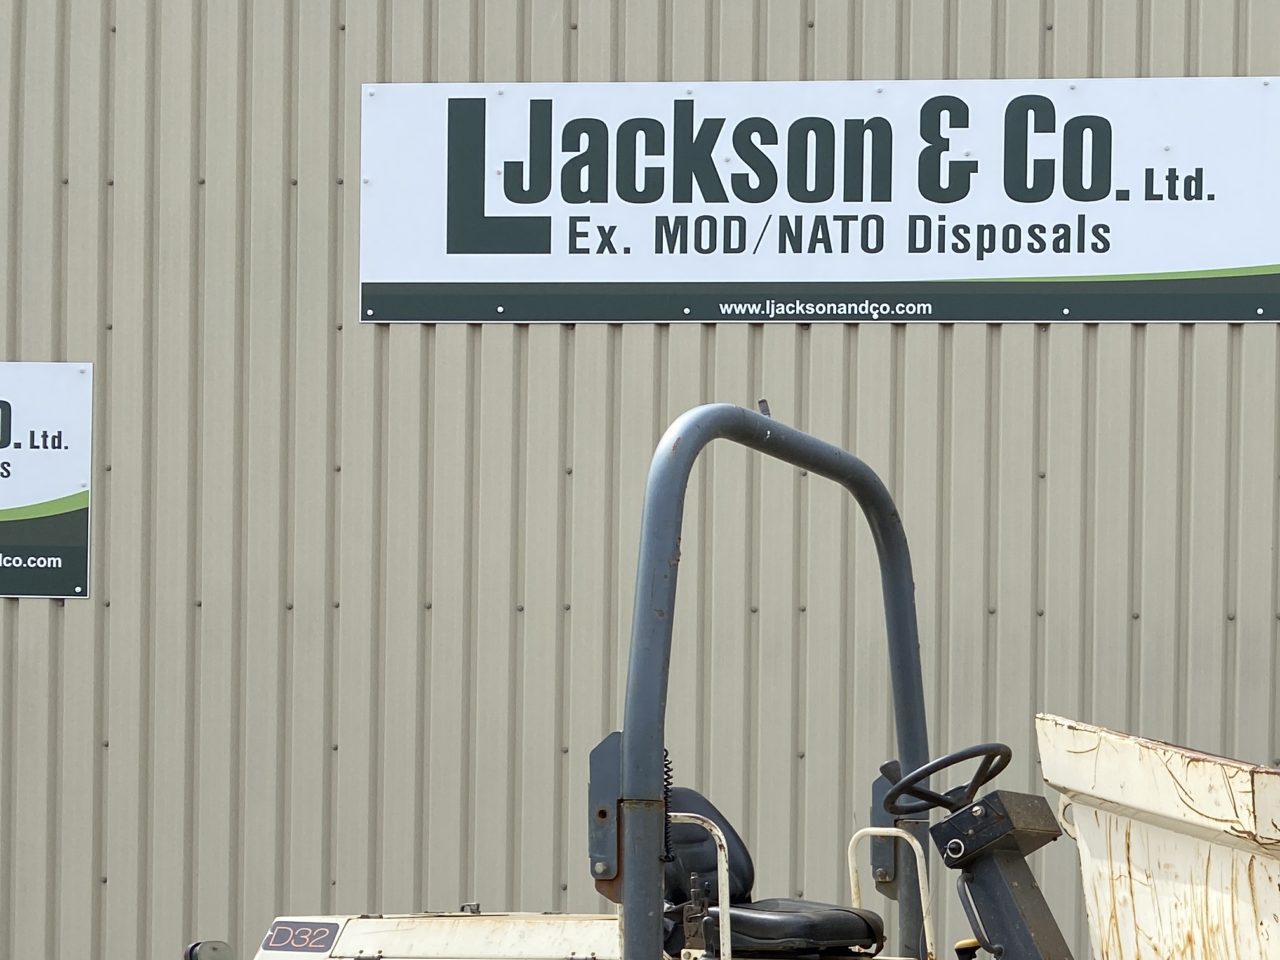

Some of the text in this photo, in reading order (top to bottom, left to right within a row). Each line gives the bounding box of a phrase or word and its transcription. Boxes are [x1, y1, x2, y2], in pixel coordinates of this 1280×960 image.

[917, 95, 979, 204] &
[1003, 94, 1130, 204] Co.
[1144, 166, 1215, 202] Ltd.
[568, 212, 1111, 261] Ex. MOD/NATO Disposals
[718, 298, 933, 319] www.ljacksonandco.com
[29, 430, 69, 450] Ltd.
[268, 926, 330, 948] D32
